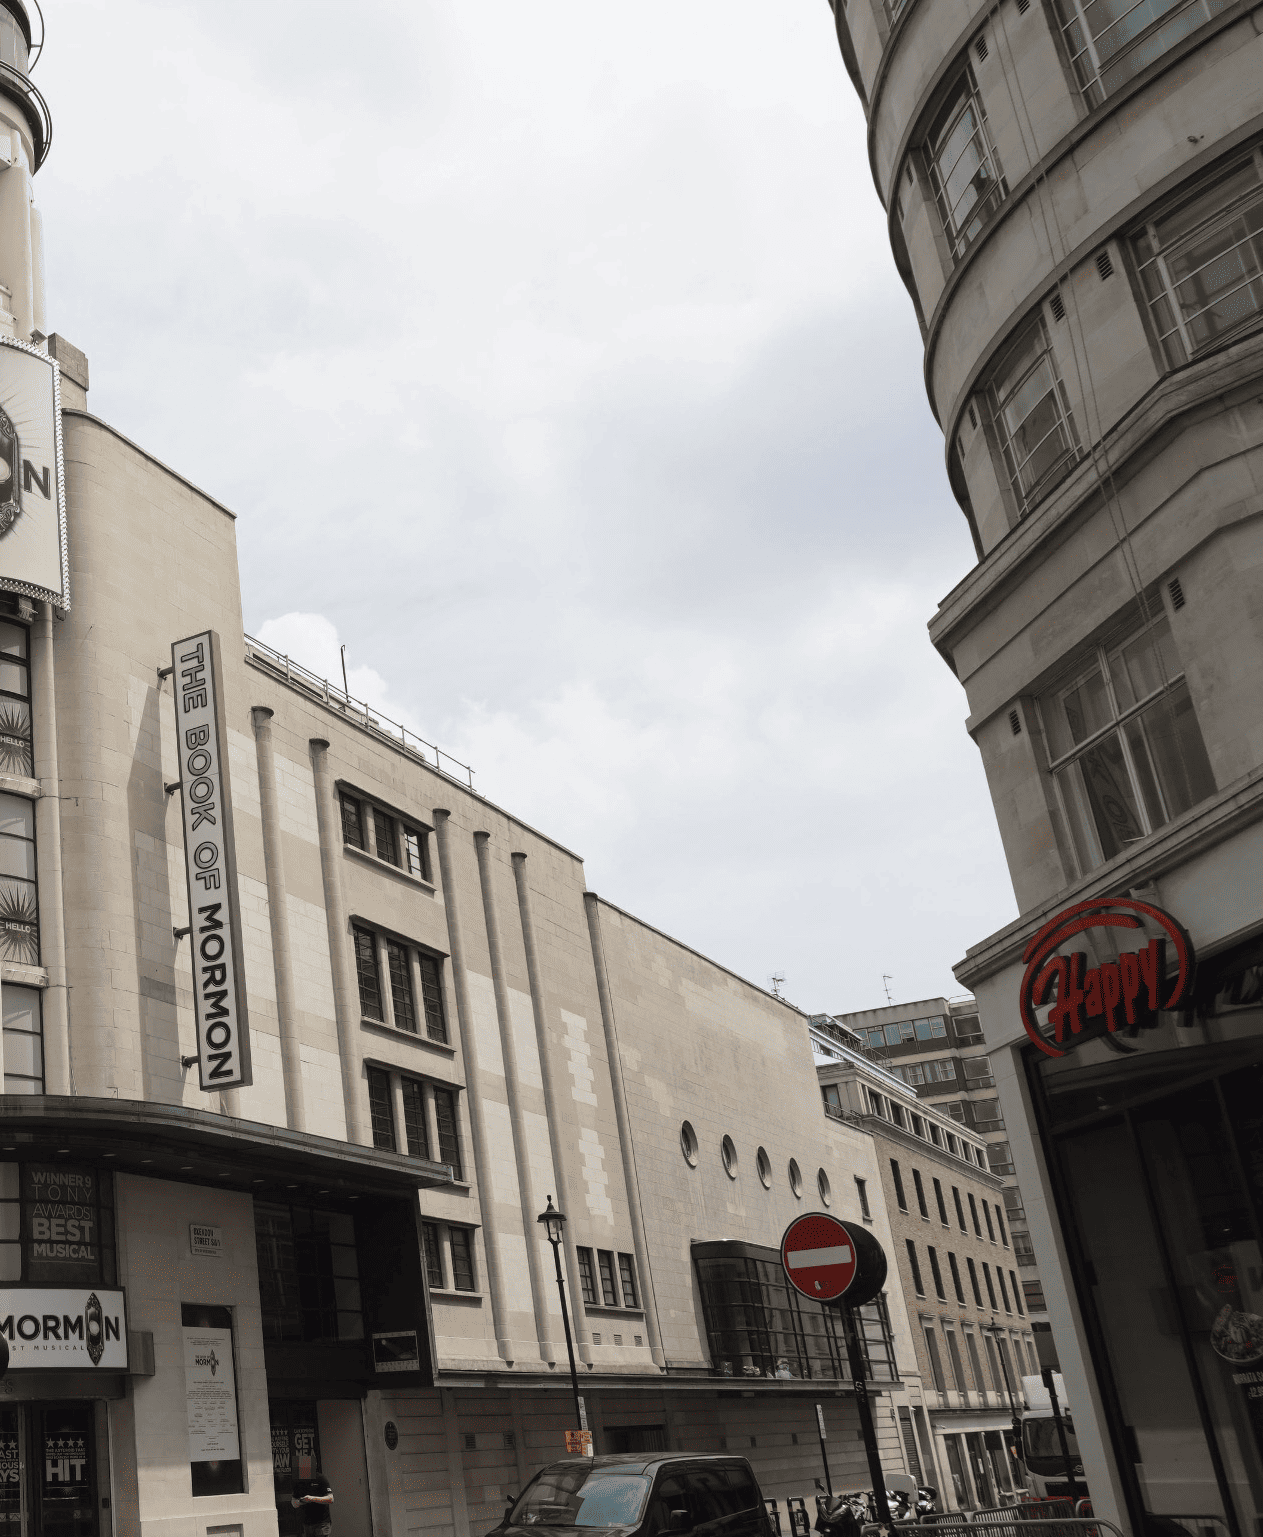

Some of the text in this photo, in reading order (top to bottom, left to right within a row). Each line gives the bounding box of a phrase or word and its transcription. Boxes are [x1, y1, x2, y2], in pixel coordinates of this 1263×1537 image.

[0, 735, 25, 748] HELLO
[180, 642, 235, 1080] THE BOOK OF MORMON
[5, 921, 31, 934] HELLO
[1033, 938, 1159, 1043] Happy
[31, 1171, 92, 1188] WINNER 9
[31, 1184, 92, 1203] TONY
[32, 1217, 94, 1242] BEST
[194, 1236, 210, 1245] STREET
[33, 1243, 95, 1260] MUSICAL
[294, 1433, 315, 1449] GET
